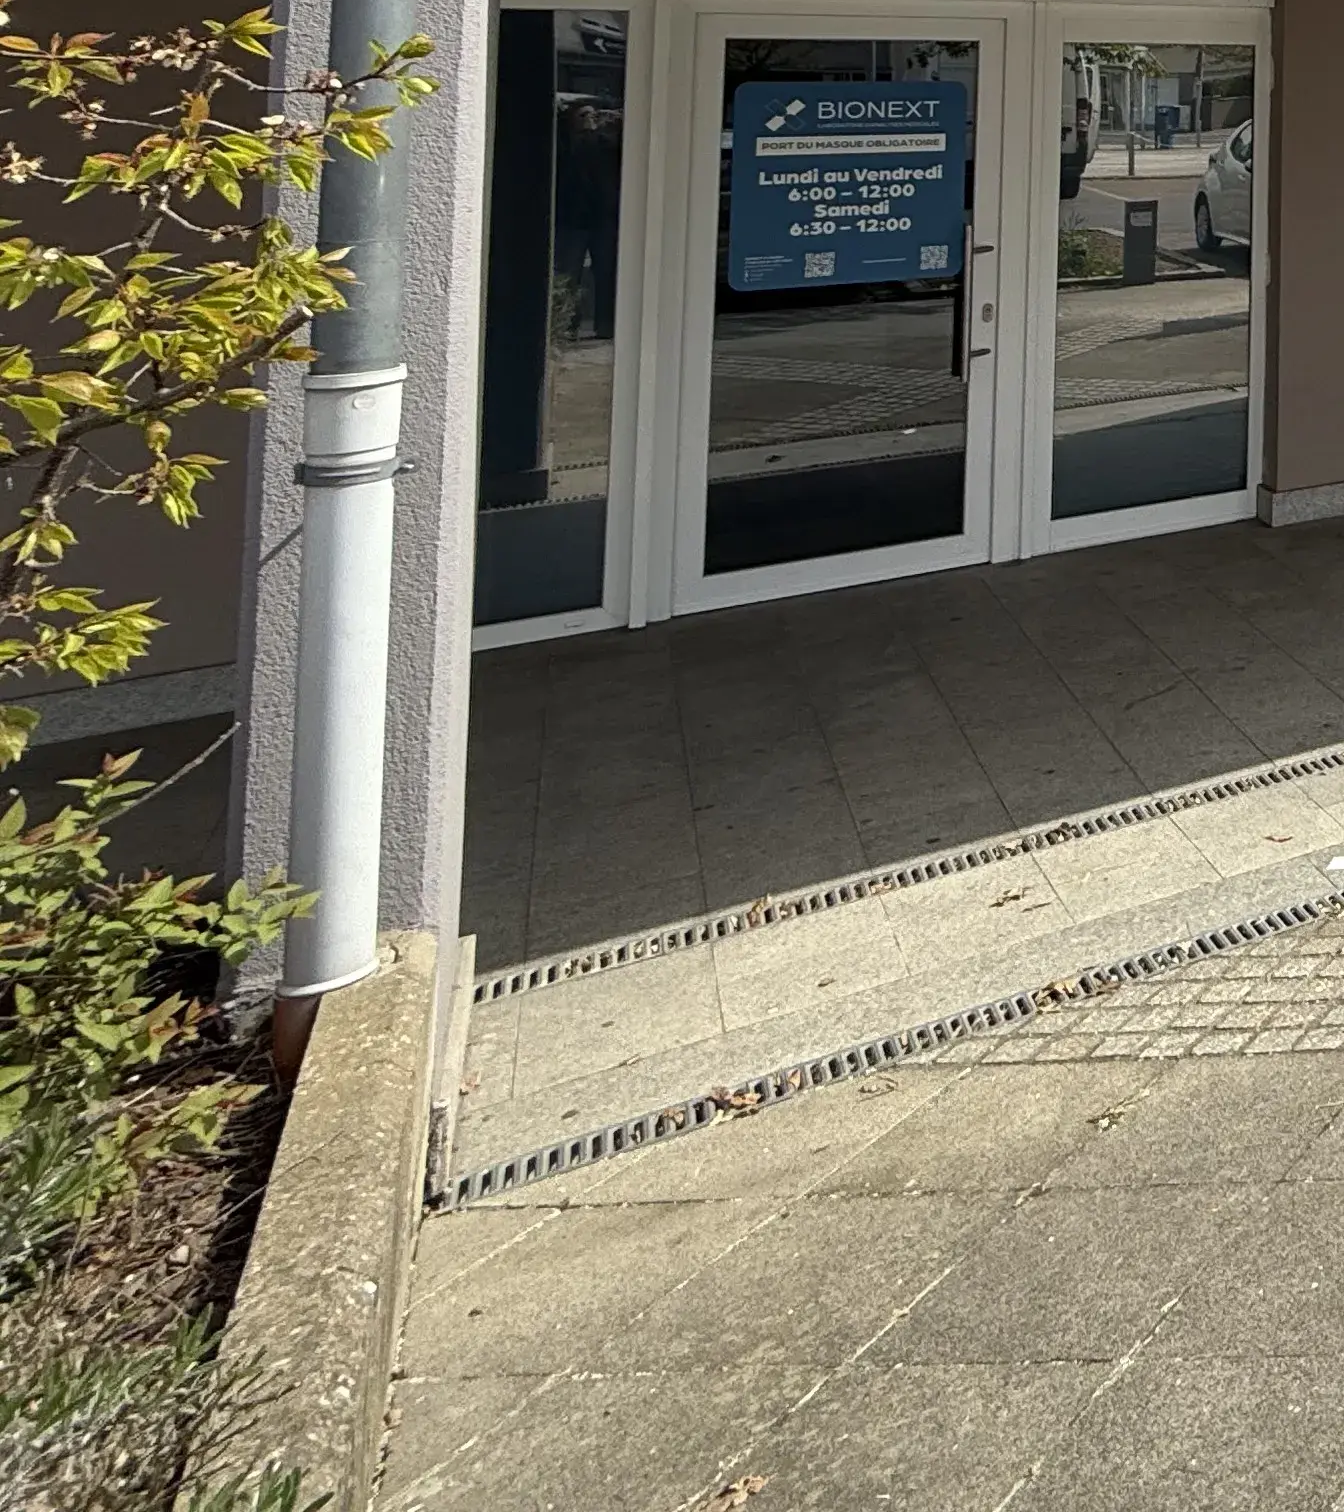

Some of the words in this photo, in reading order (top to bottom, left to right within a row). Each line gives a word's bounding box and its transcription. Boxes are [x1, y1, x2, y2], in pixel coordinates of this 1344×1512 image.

[817, 100, 941, 120] BIONEXT
[761, 141, 793, 150] PORT
[796, 141, 813, 149] DU
[816, 140, 863, 149] MASQUE
[866, 138, 940, 148] OBLIGATOIRE
[758, 168, 819, 186] Lundi
[823, 170, 850, 183] au
[854, 164, 943, 182] Vendredi
[788, 186, 837, 202] 6:00
[858, 183, 916, 199] 12:00
[814, 199, 890, 219] Samedi
[790, 220, 837, 237] 6:30
[856, 217, 912, 233] 12:00
